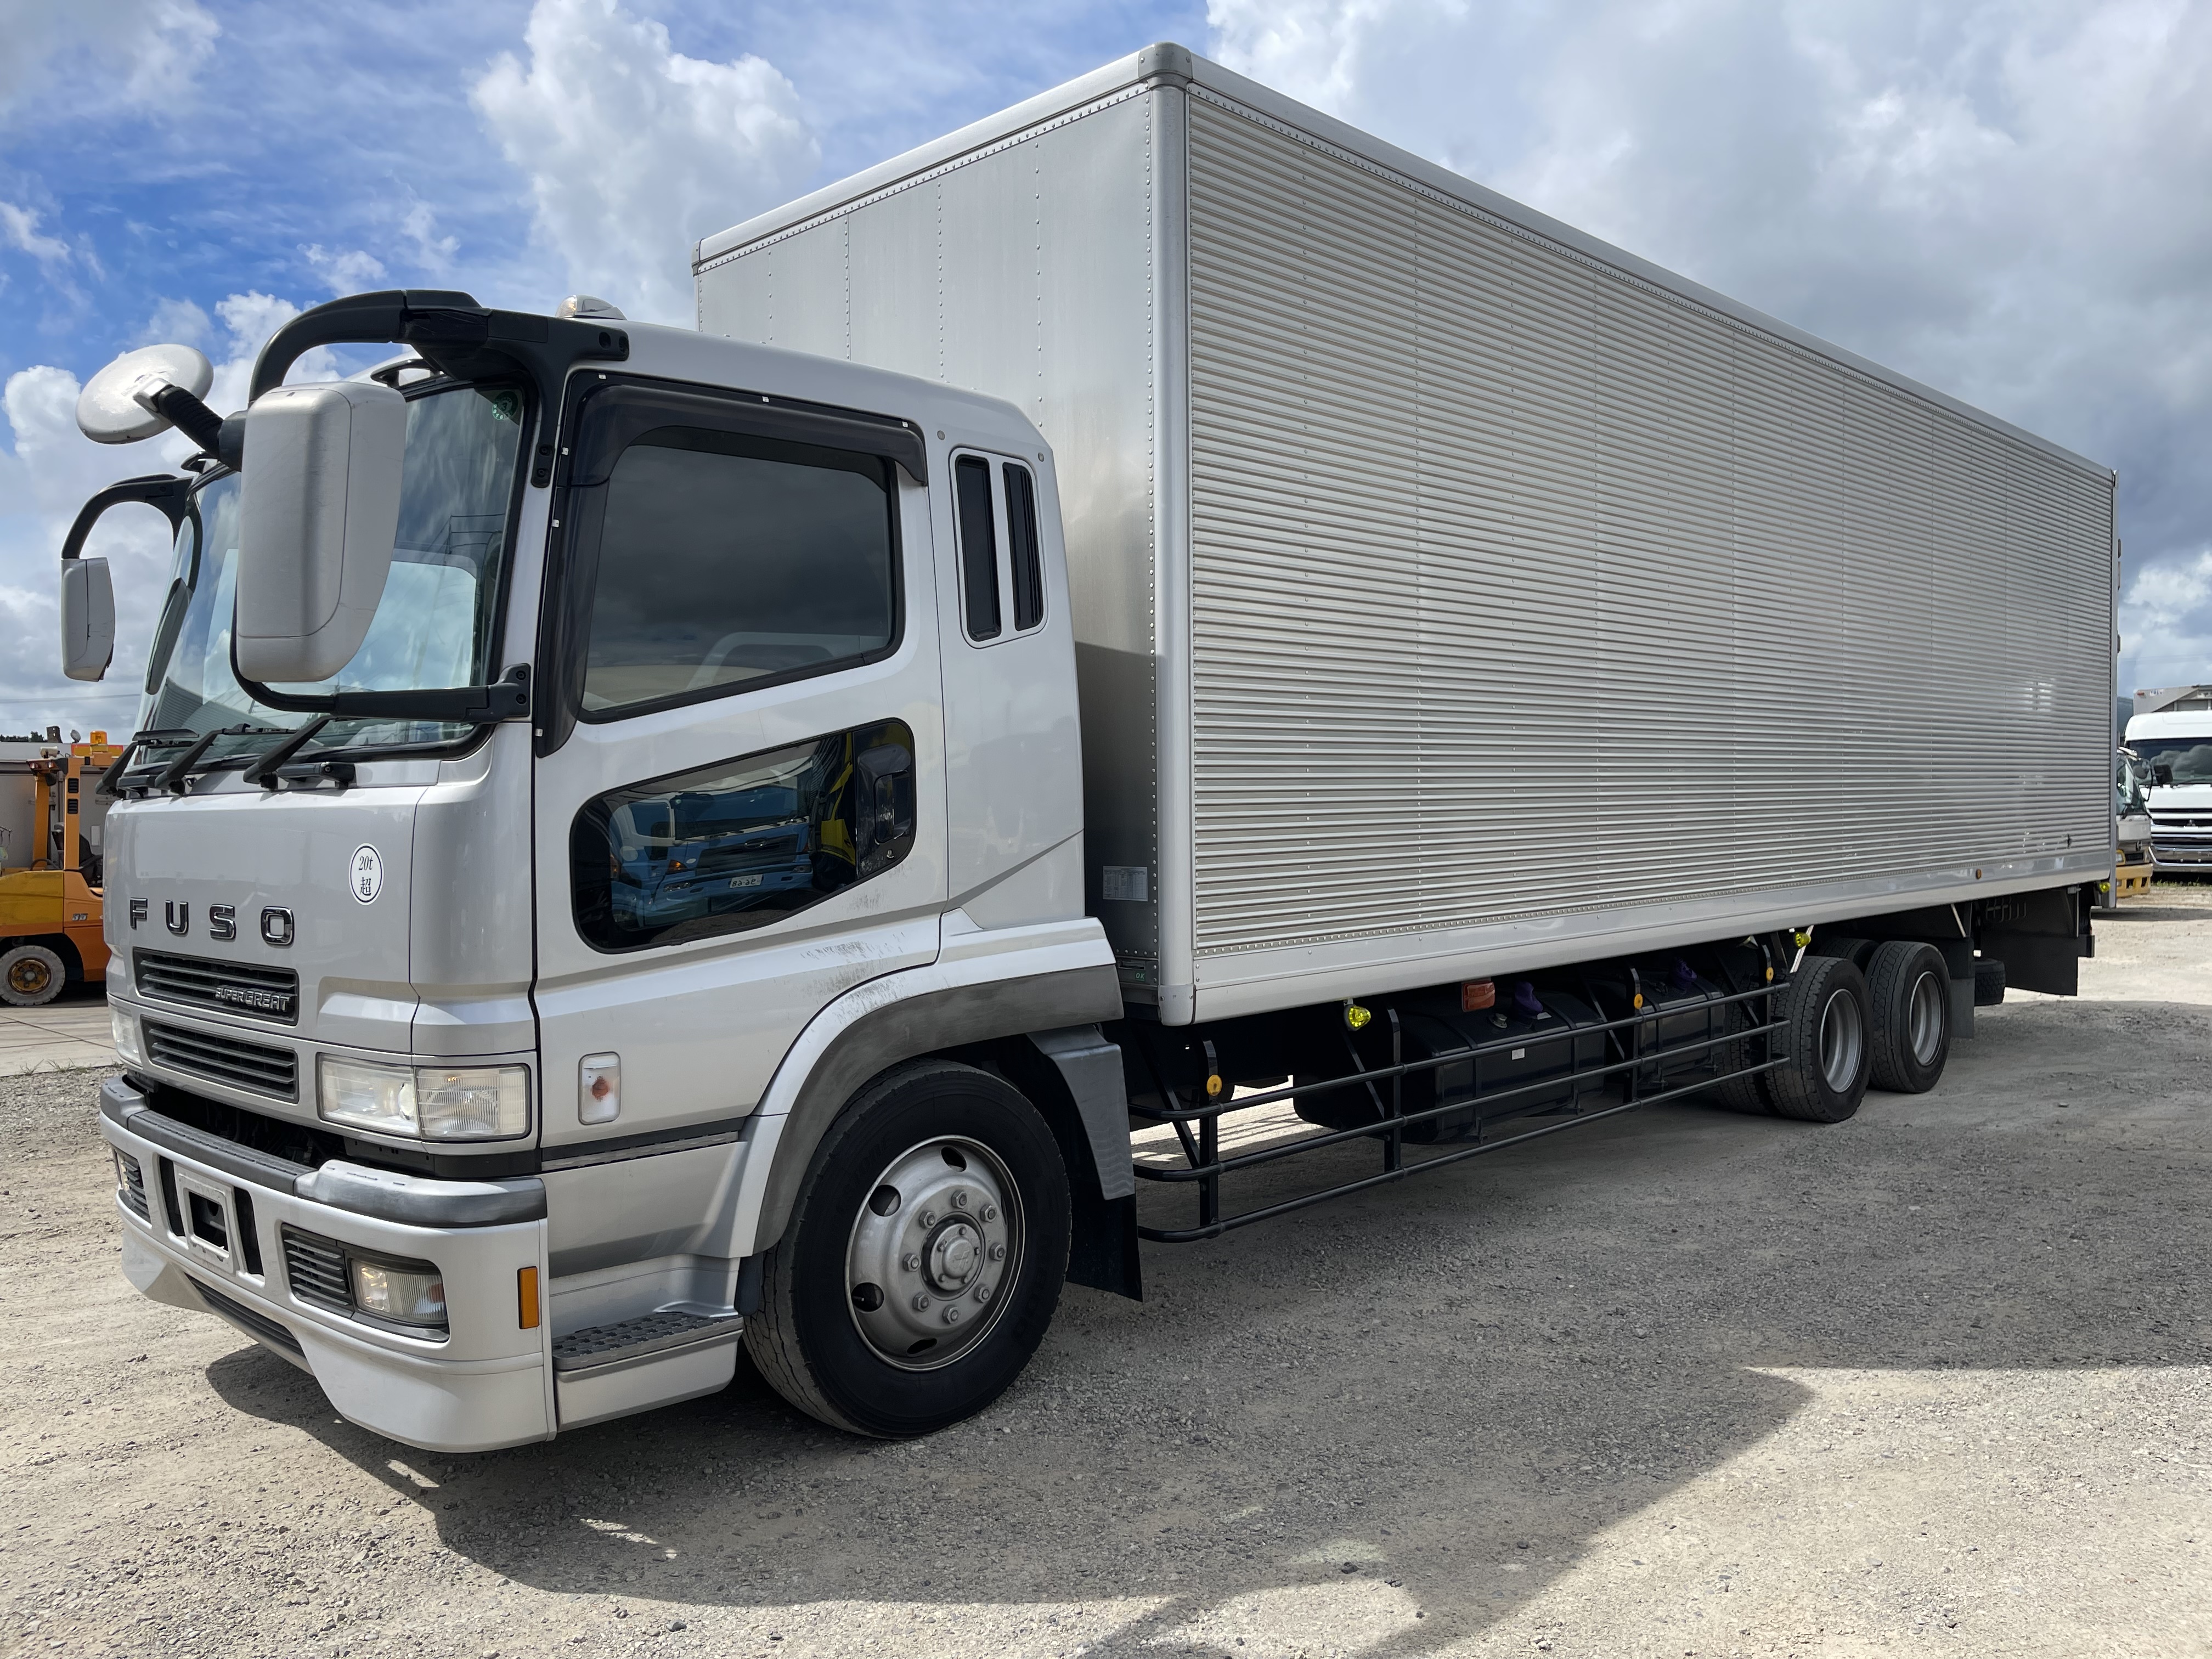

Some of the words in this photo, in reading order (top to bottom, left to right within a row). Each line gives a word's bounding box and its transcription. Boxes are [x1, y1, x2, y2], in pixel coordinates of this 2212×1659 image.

[358, 856, 373, 871] 20t
[360, 877, 371, 896] 超
[130, 897, 295, 945] FUSO
